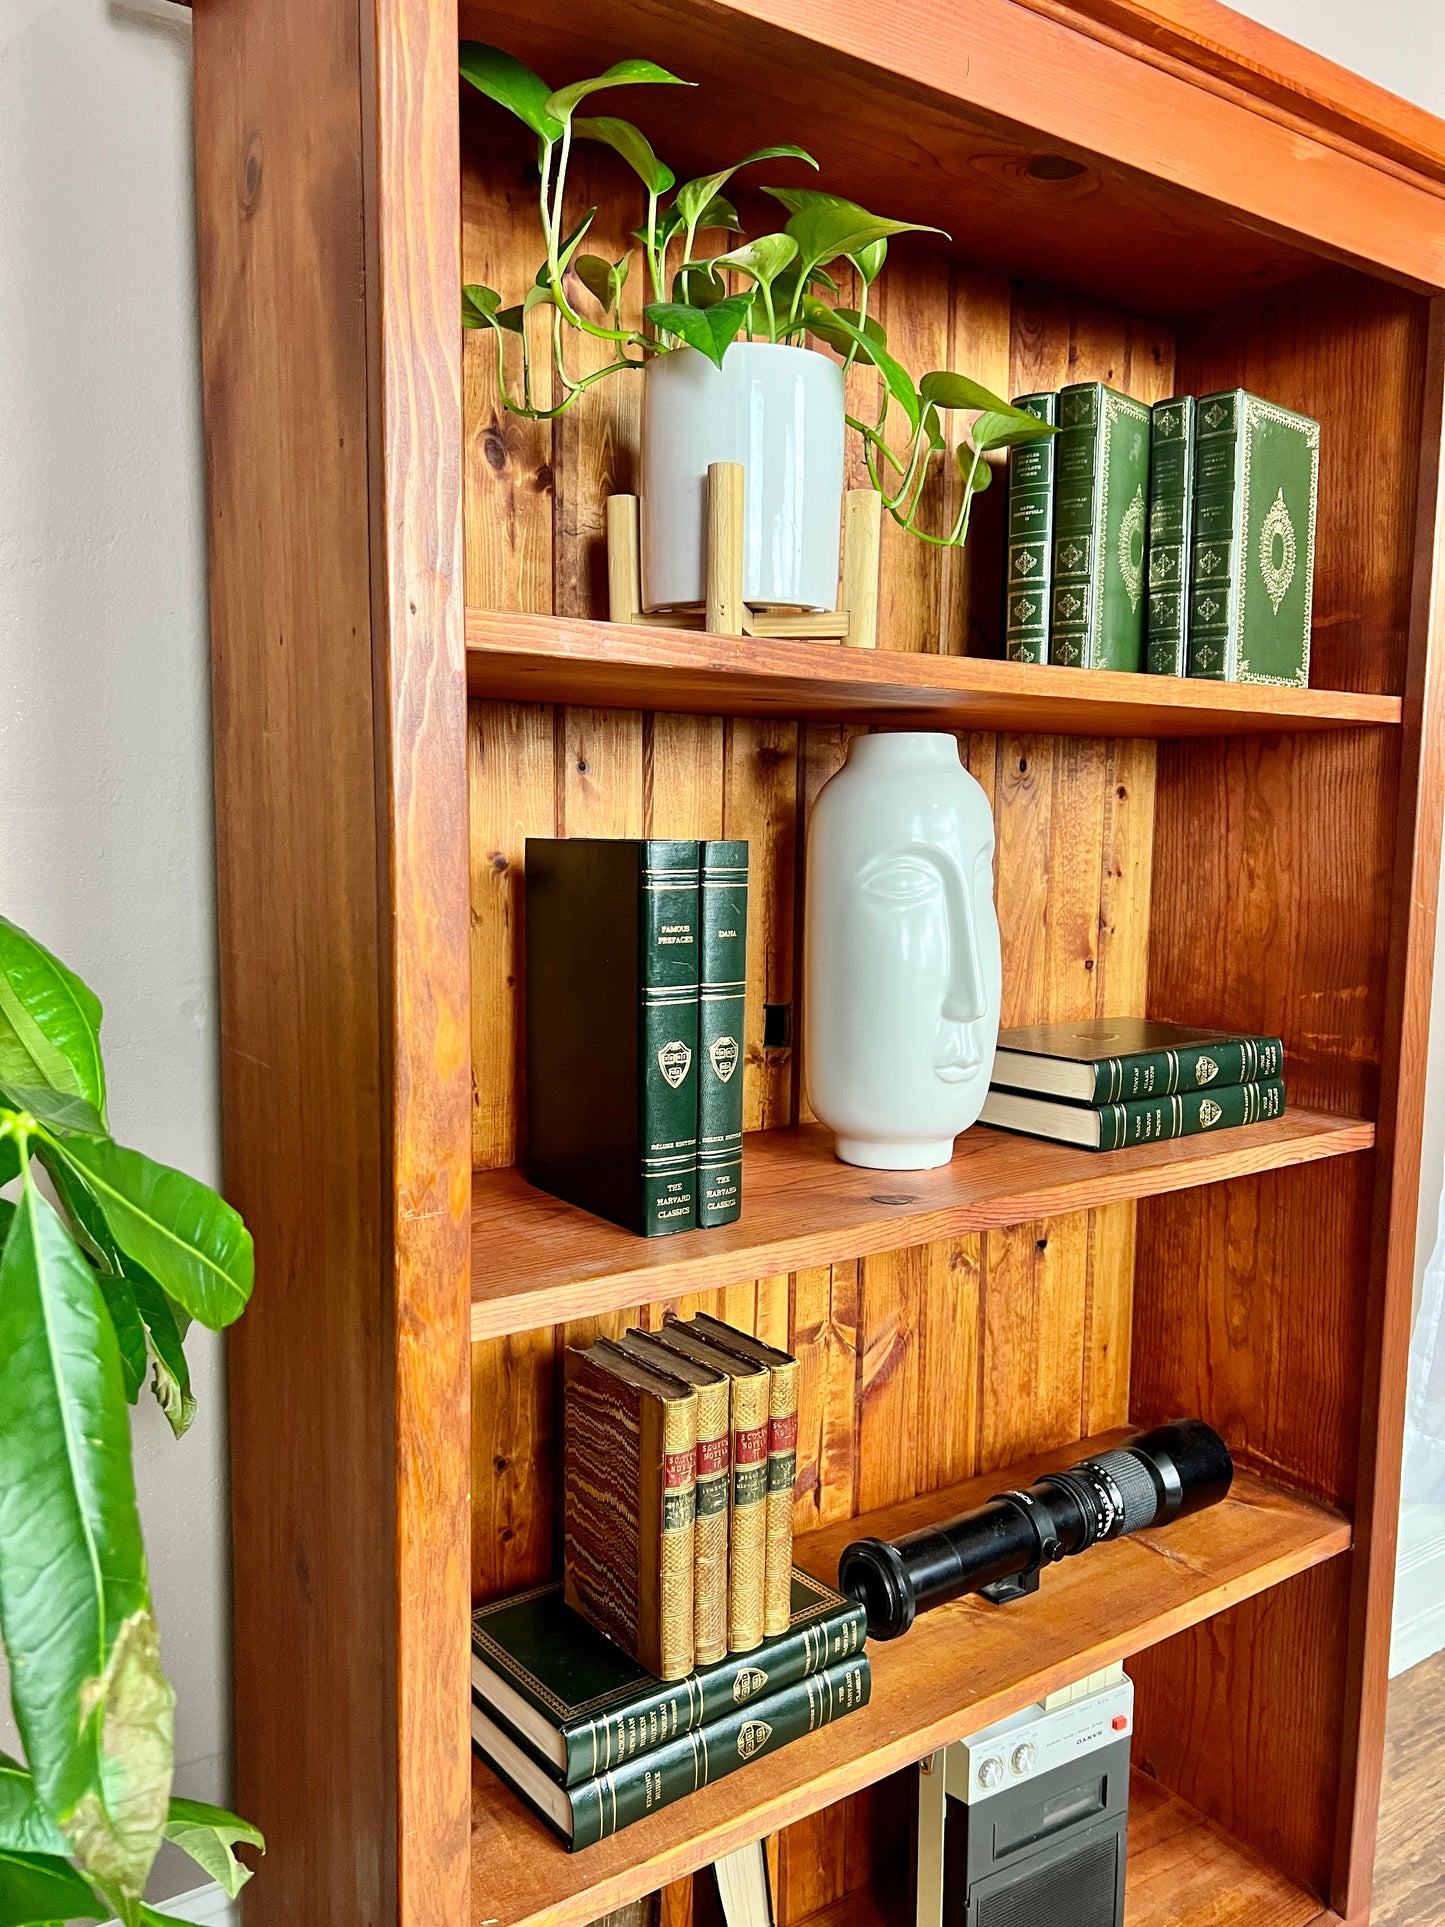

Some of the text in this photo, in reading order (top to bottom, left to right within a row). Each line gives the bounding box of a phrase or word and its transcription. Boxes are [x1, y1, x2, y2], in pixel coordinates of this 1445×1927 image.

[661, 925, 691, 934] FAMOUS
[718, 930, 737, 938] DANA
[657, 936, 694, 945] PREFACES
[716, 1175, 731, 1184] THE
[667, 1183, 683, 1192] THE
[706, 1187, 737, 1198] HARVARD
[656, 1194, 691, 1206] HARVARD
[707, 1199, 737, 1210] CLASSICS
[657, 1206, 690, 1219] CLASSICS
[841, 1622, 849, 1657] HARVARD
[850, 1620, 858, 1653] CLASSICS
[649, 1711, 658, 1743] HUXLEY
[659, 1703, 668, 1740] THOREAU
[628, 1717, 636, 1754] NEWMAN
[639, 1715, 647, 1747] RUSKIN
[1076, 1730, 1103, 1745] SANYO
[616, 1716, 625, 1764] THACKERAY
[644, 1771, 652, 1809] EDMUND
[654, 1770, 662, 1800] BURKE
